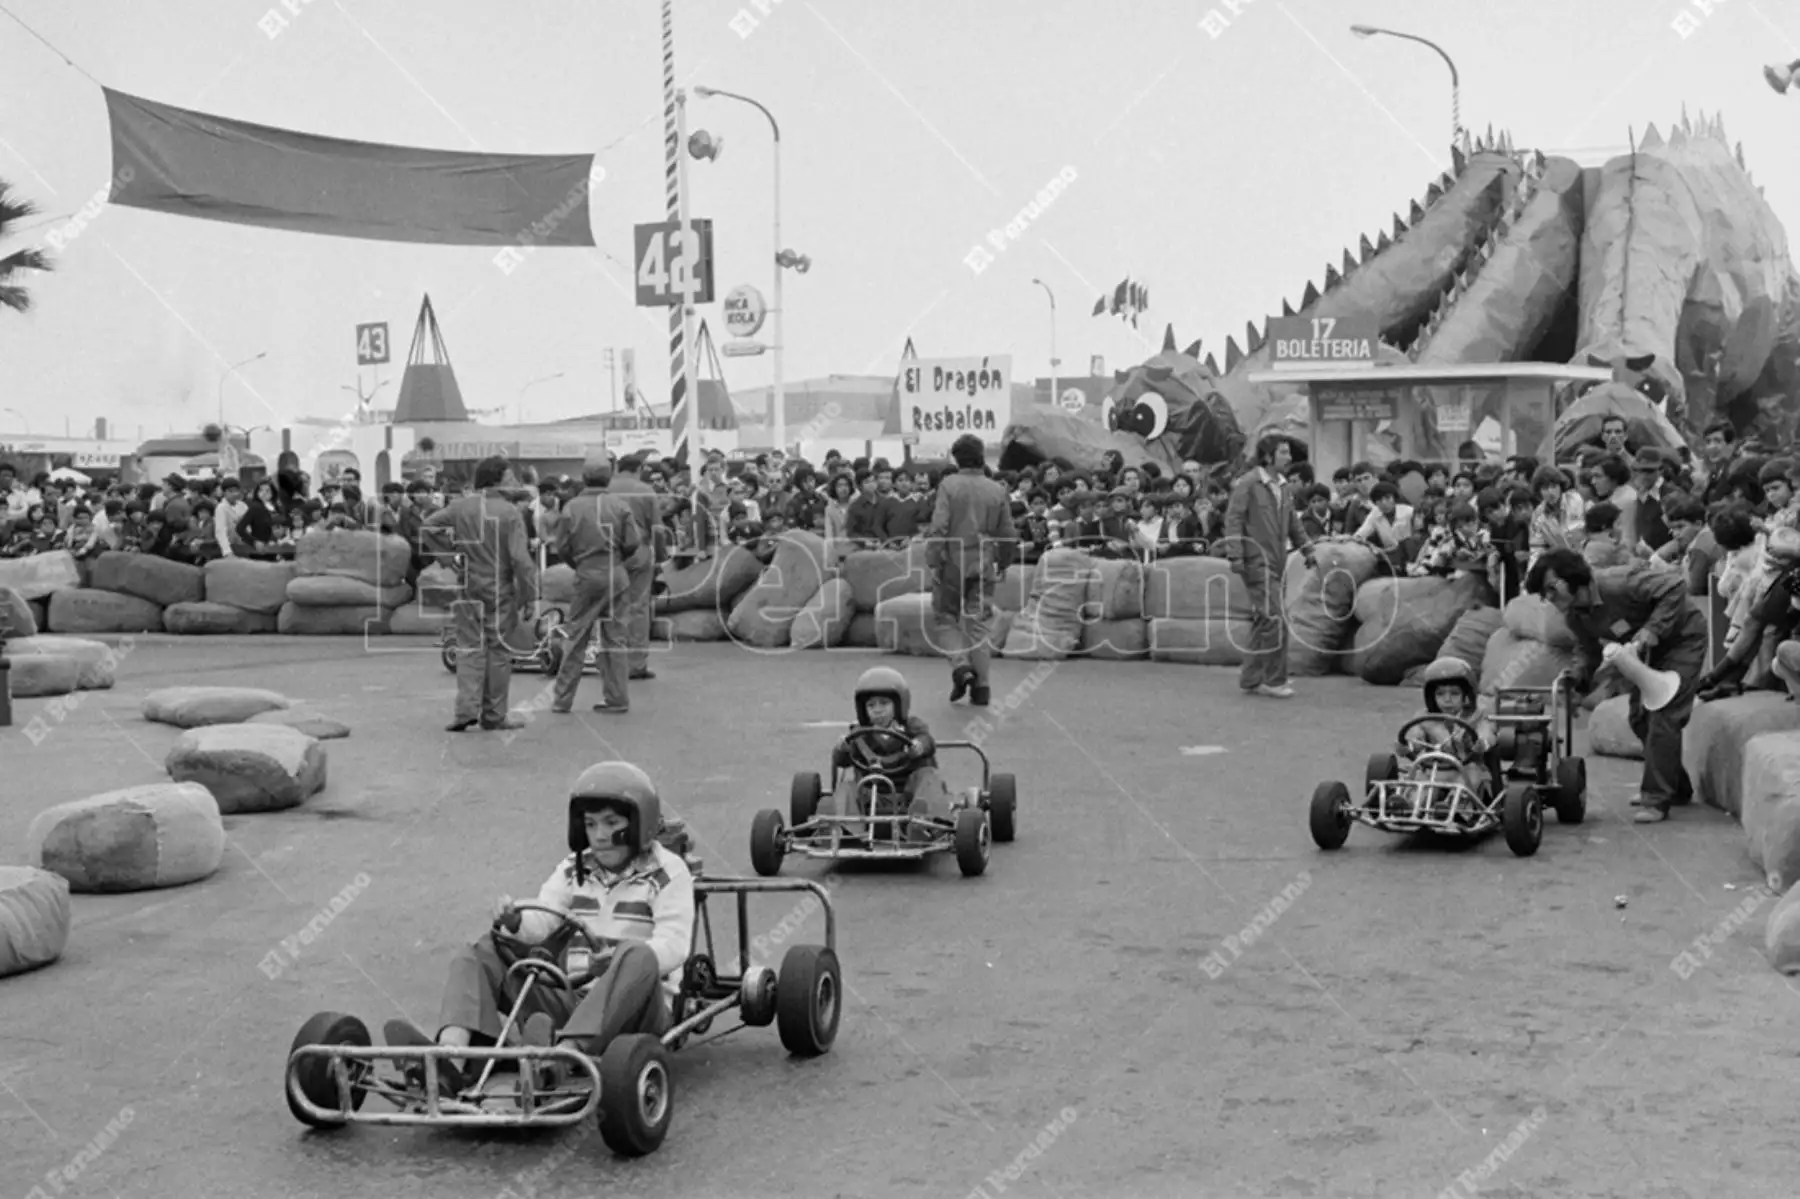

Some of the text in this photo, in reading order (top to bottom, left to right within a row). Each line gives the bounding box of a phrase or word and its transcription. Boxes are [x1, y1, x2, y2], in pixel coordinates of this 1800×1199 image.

[637, 228, 702, 295] 42
[358, 327, 386, 360] 43
[1310, 317, 1336, 341] 17
[1276, 338, 1372, 358] BOLETERIA
[905, 355, 1003, 397] El Dragón
[912, 404, 995, 431] Resbalon
